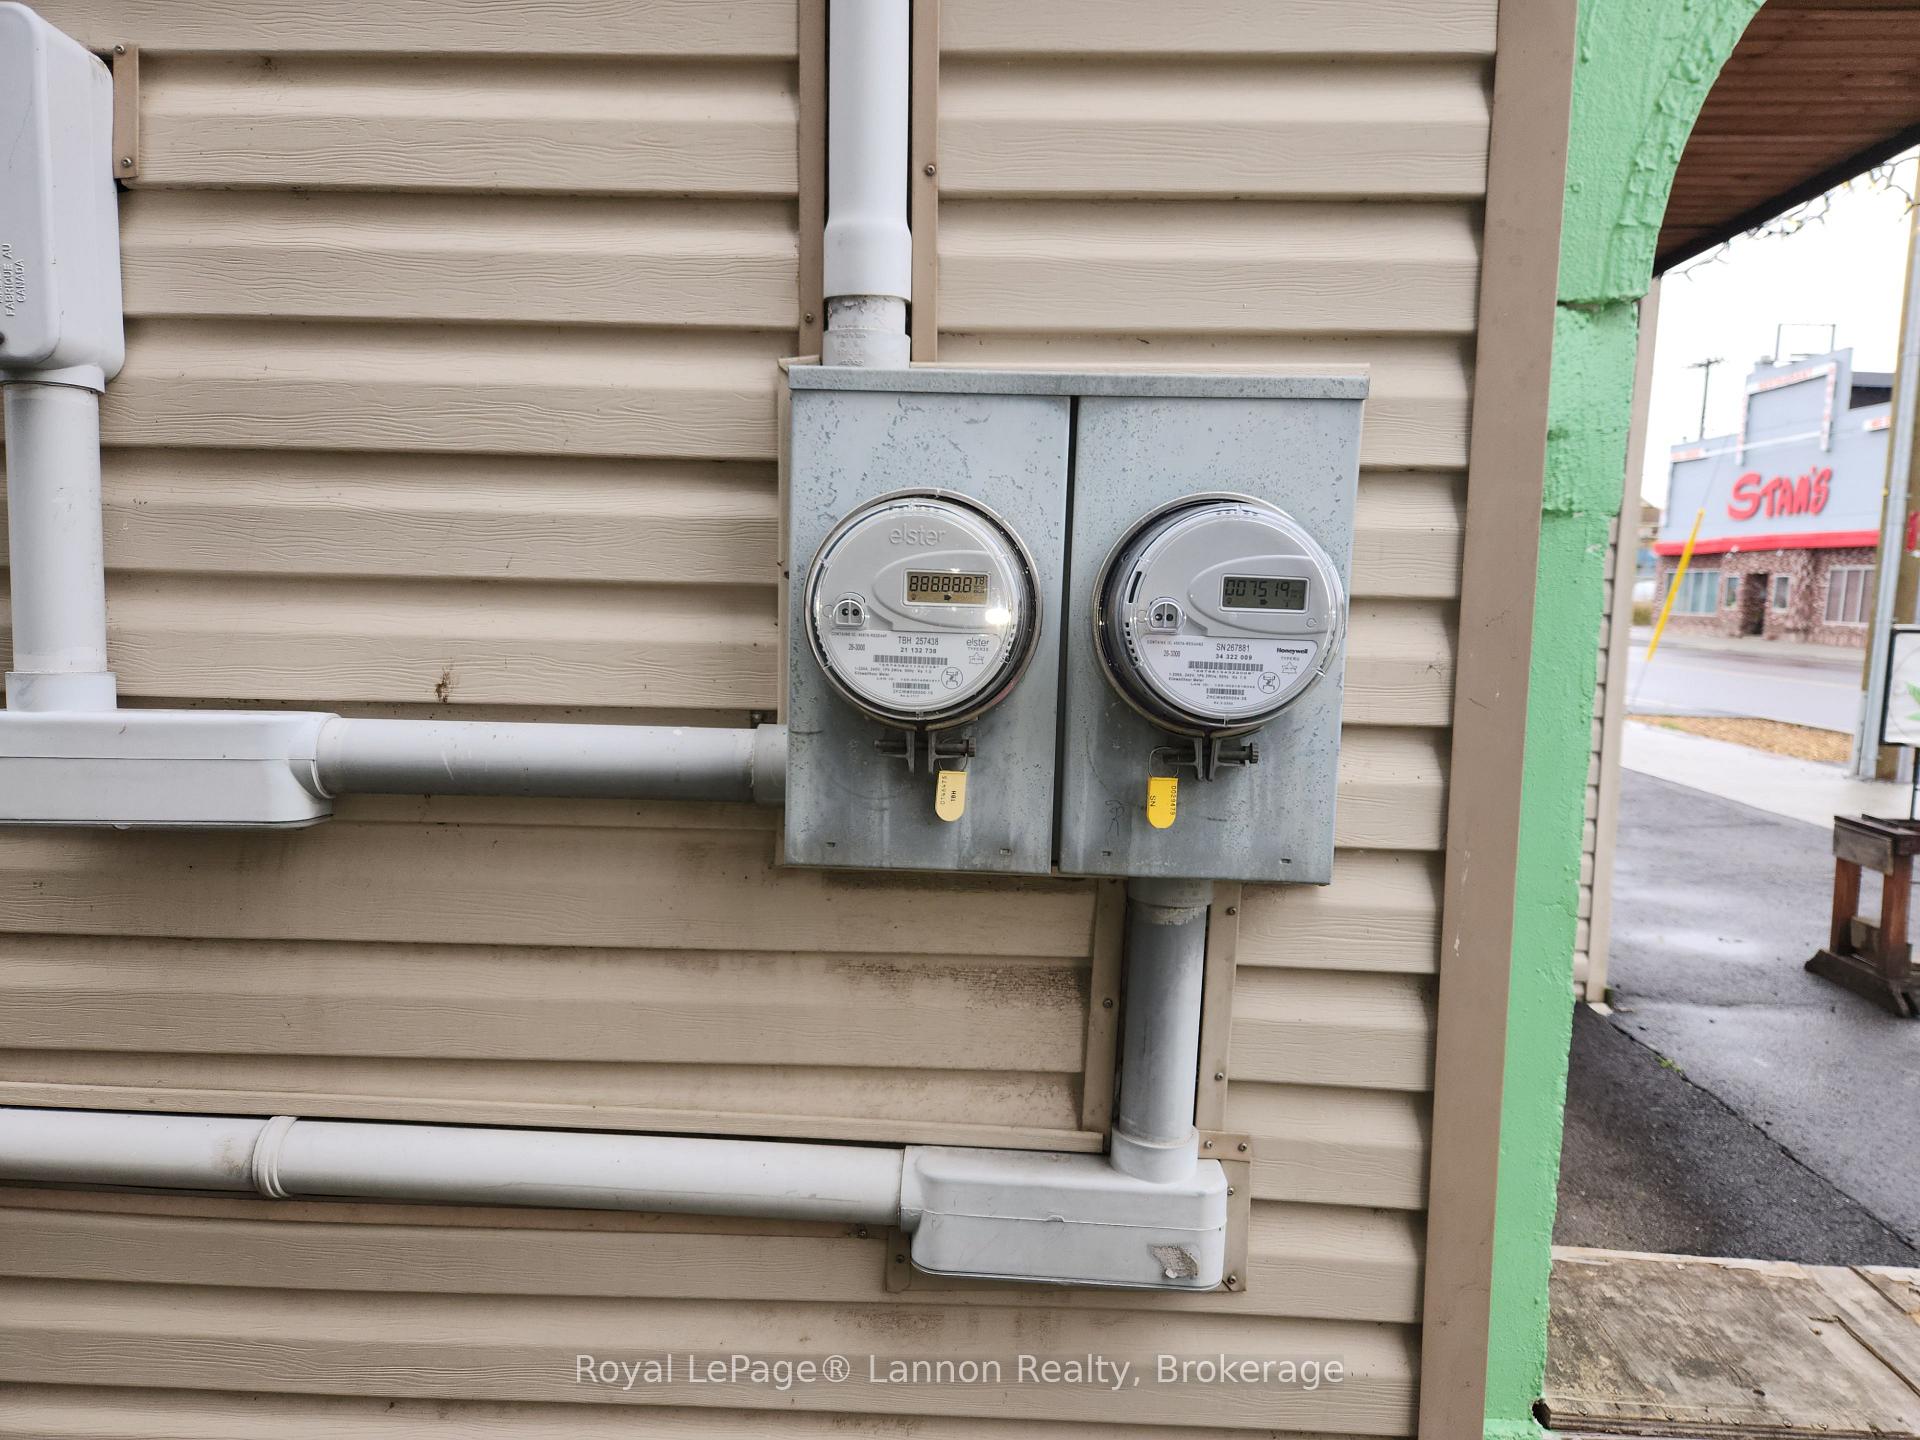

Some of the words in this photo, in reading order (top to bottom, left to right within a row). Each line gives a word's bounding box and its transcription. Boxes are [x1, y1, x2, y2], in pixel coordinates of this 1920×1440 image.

[2, 243, 12, 260] AU
[15, 259, 25, 303] CANADA
[3, 263, 16, 317] FABRIQUE
[889, 523, 946, 546] elster
[898, 635, 912, 645] TBH
[966, 637, 990, 647] elster
[1216, 643, 1226, 652] SN
[1276, 647, 1309, 655] Honeywell
